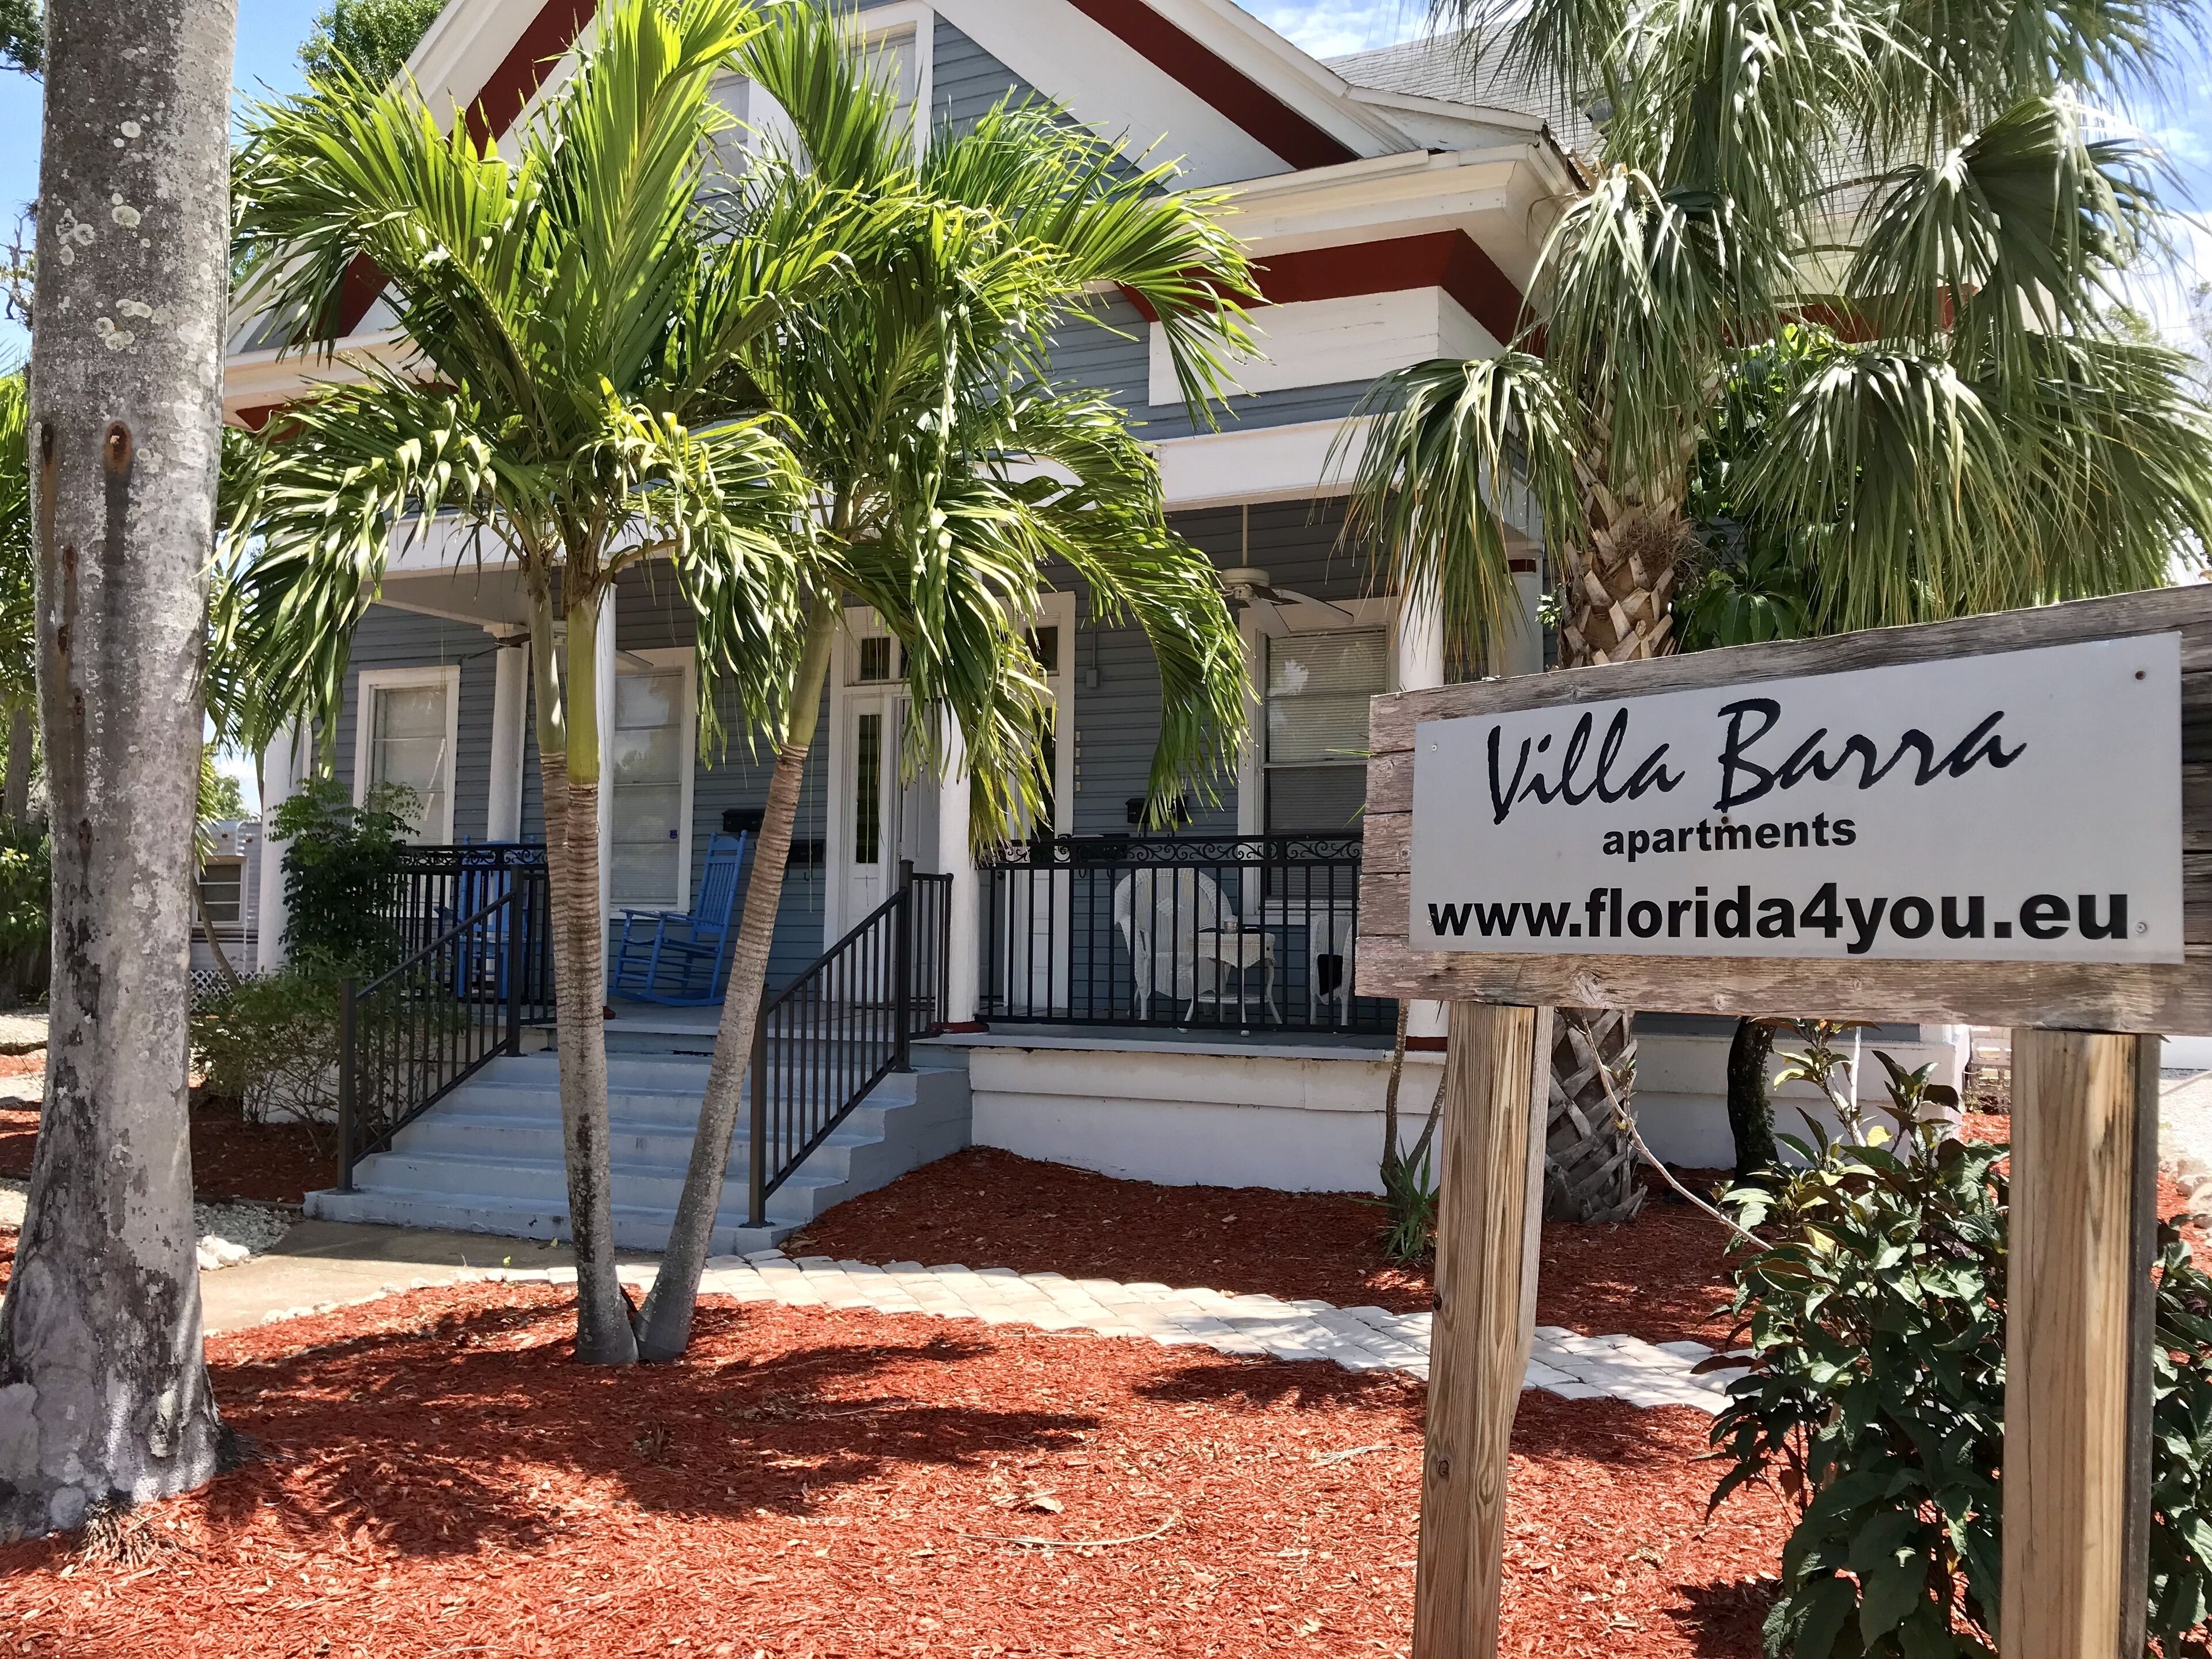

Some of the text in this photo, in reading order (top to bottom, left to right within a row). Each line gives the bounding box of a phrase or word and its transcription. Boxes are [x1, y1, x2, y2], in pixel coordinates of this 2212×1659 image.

[1487, 698, 2027, 825] Villa Barra
[1603, 812, 1857, 863] apartments
[1427, 882, 2128, 955] www.florida4you.eu
